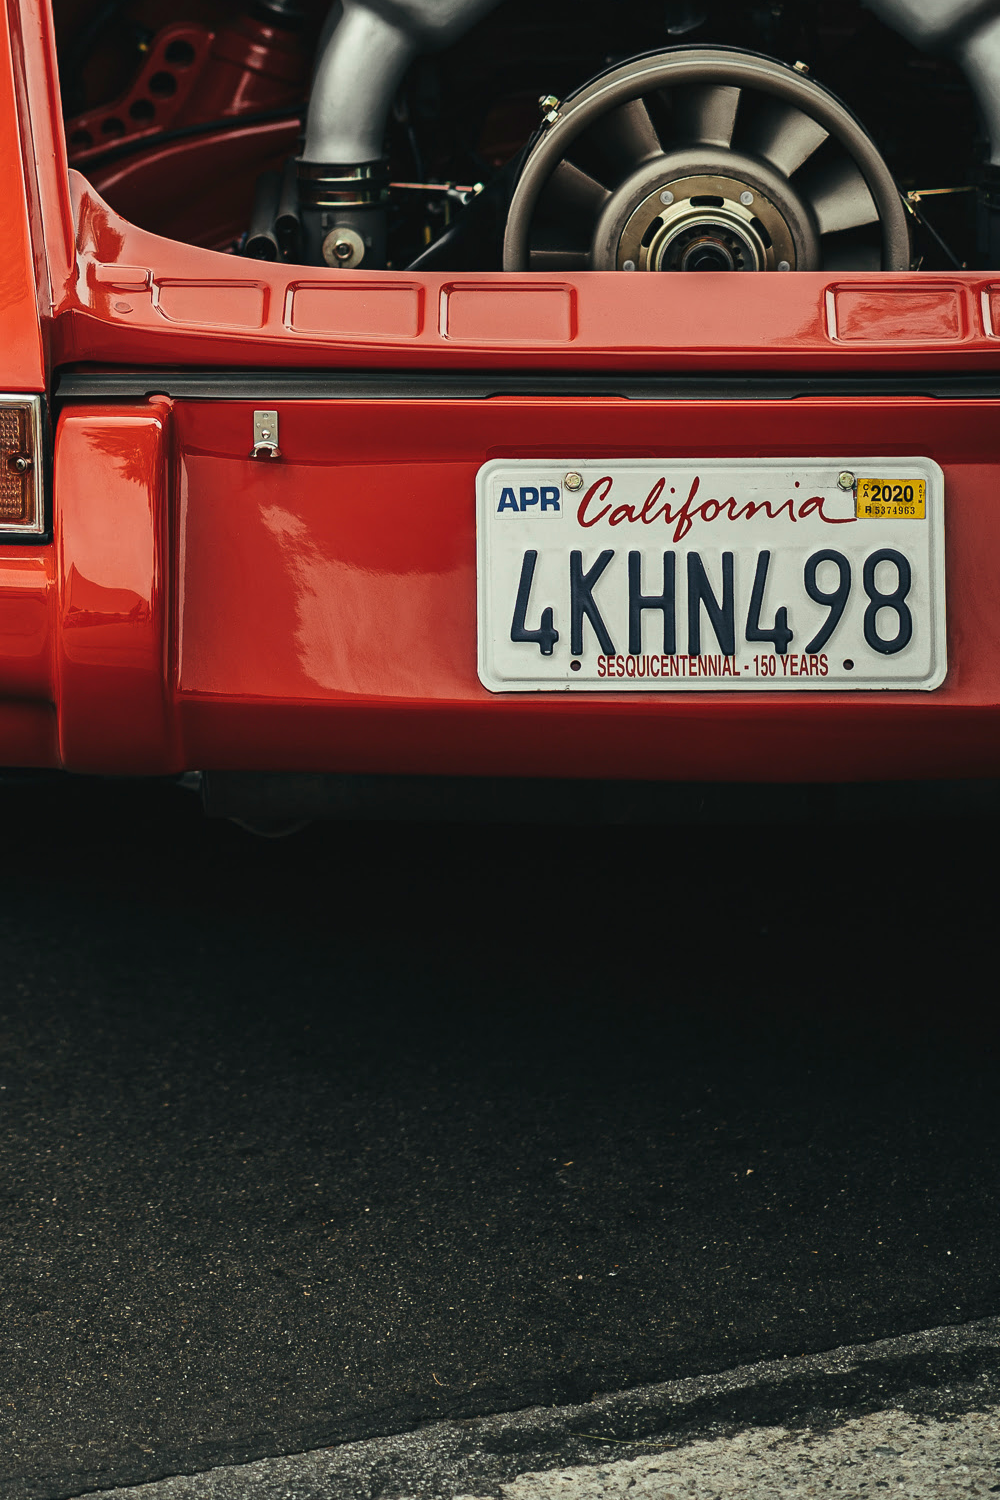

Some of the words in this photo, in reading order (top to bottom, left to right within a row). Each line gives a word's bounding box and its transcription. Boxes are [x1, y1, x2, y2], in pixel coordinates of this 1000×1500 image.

[497, 486, 561, 513] APR
[871, 485, 914, 502] 2020
[577, 476, 857, 542] California
[875, 506, 915, 514] 5374963
[510, 548, 913, 656] 4KHN498
[597, 655, 741, 678] SESQUICENTENNIAL
[753, 655, 777, 677] 150
[779, 654, 829, 677] YEARS
